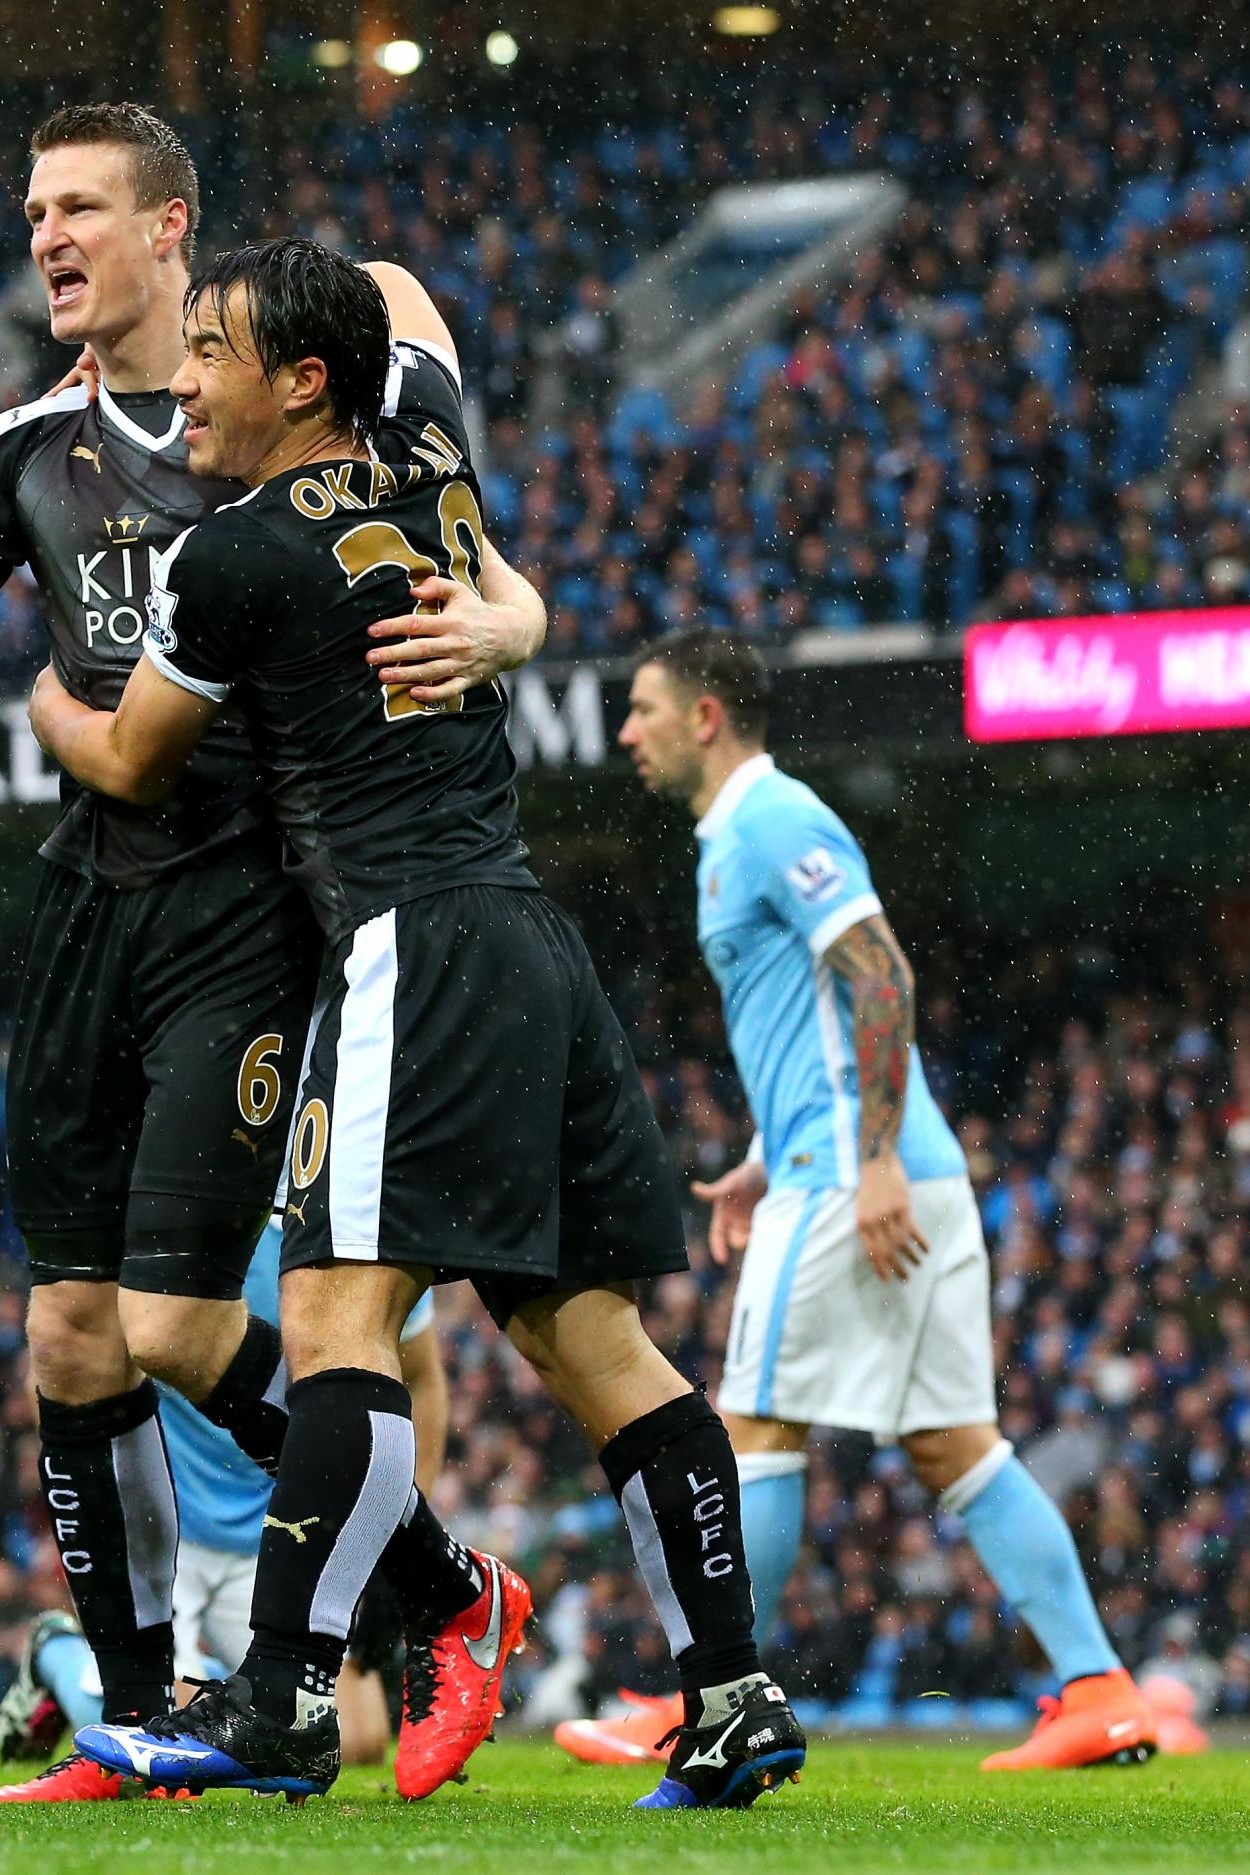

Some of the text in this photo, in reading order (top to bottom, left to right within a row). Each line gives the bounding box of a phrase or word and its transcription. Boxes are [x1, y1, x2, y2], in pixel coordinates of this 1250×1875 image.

[237, 1033, 283, 1126] 6
[44, 1456, 93, 1574] LCFC
[686, 1472, 734, 1579] LCFC
